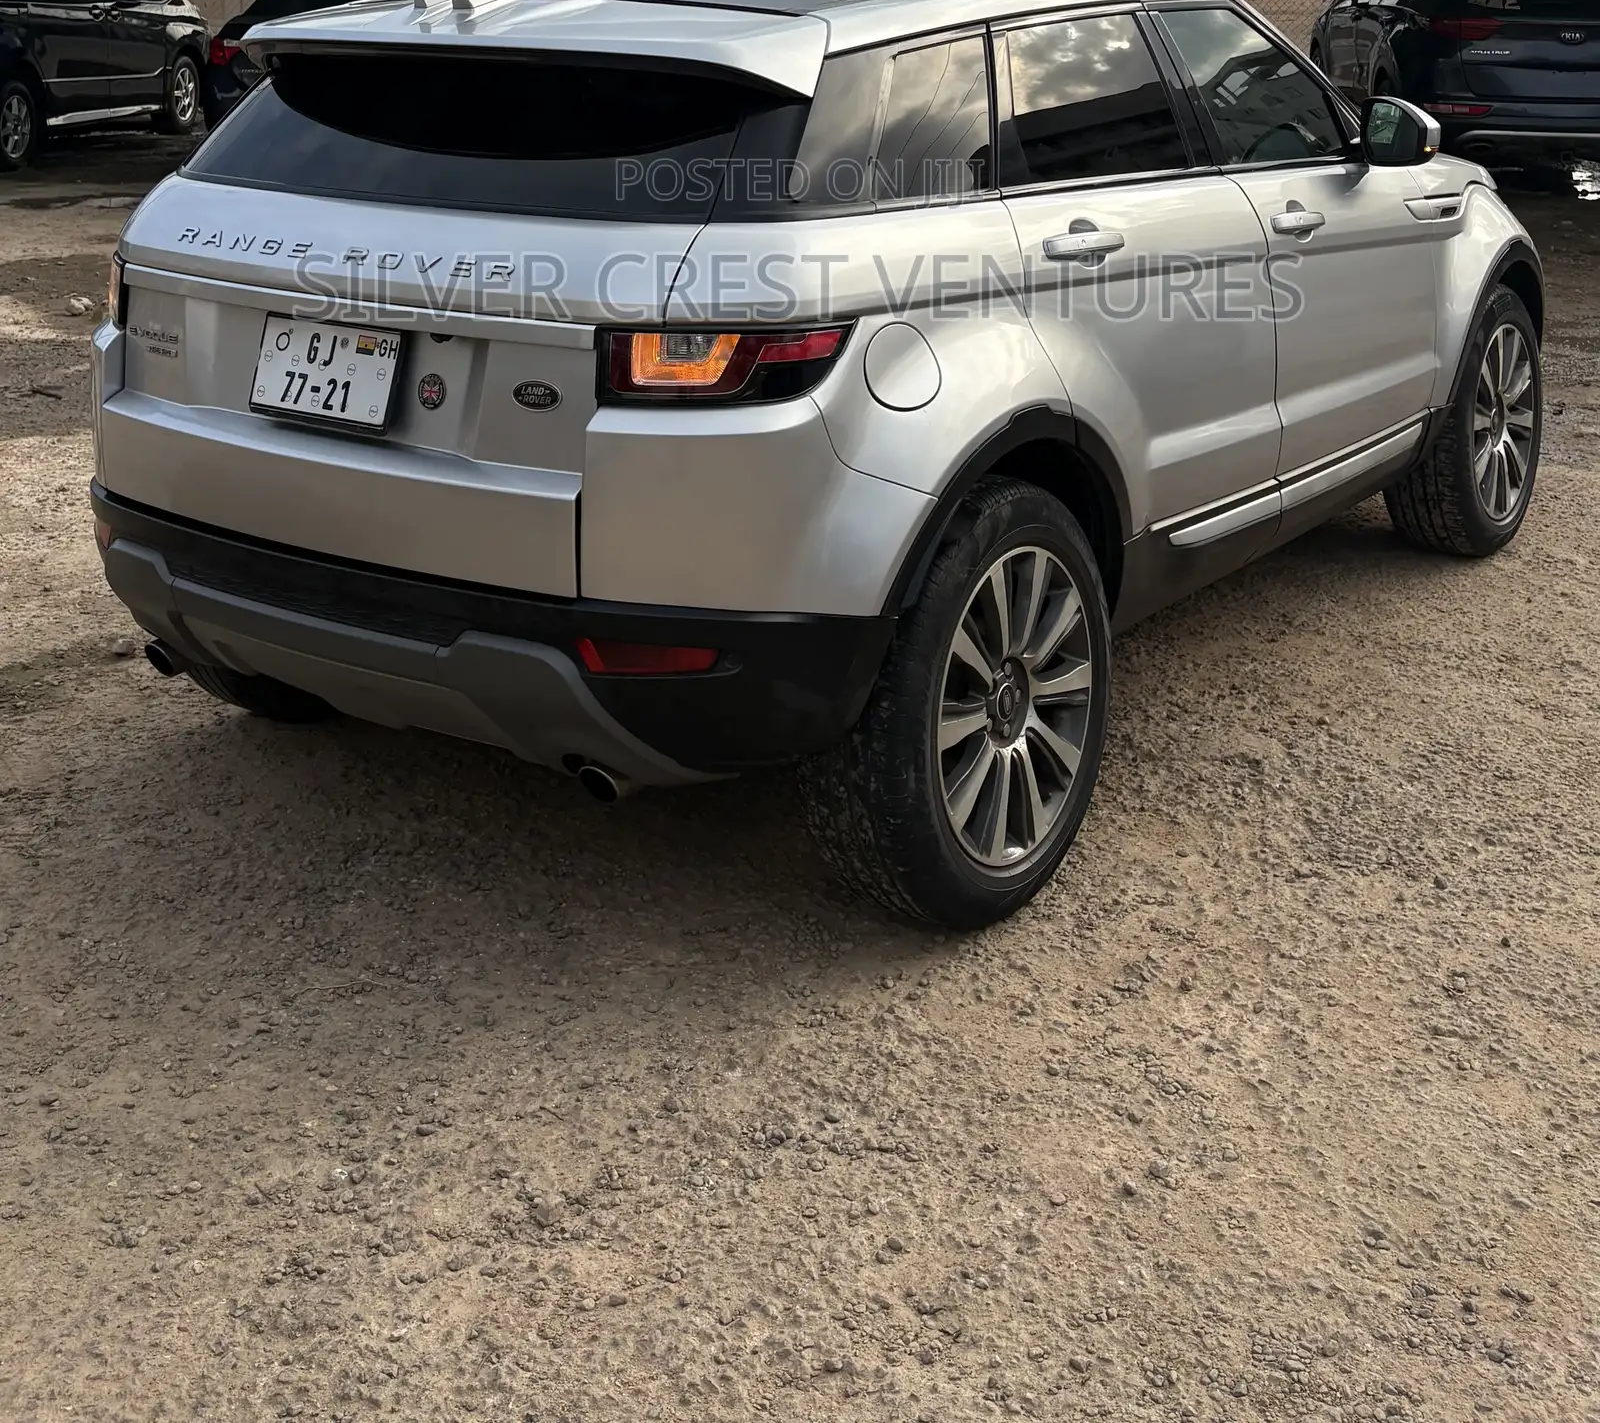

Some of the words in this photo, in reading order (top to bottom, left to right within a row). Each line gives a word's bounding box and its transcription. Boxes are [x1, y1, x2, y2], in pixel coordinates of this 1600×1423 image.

[1565, 32, 1581, 41] KIA
[177, 226, 312, 259] RANGE
[341, 246, 516, 282] ROVER
[306, 332, 338, 367] GJ
[378, 338, 399, 360] GH
[280, 370, 351, 413] 77-21
[521, 385, 545, 396] LAND
[522, 395, 552, 405] ROVER
